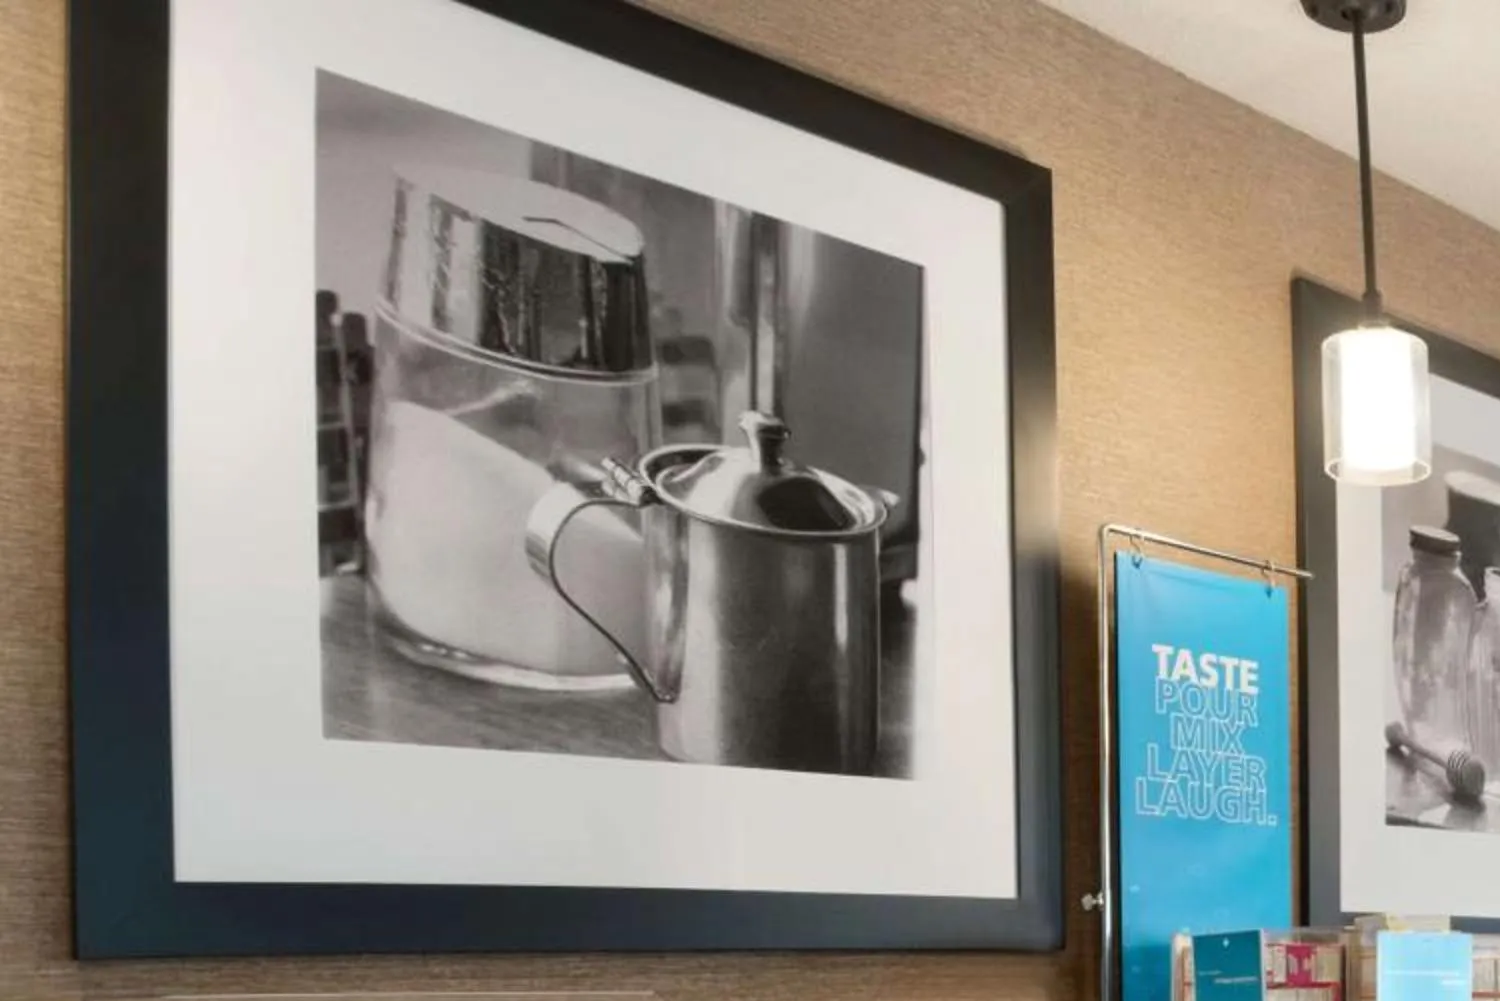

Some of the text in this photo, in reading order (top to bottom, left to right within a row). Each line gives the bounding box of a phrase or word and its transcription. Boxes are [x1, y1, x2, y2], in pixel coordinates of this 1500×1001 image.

[1152, 643, 1259, 695] TASTE
[1155, 675, 1259, 727] POUR
[1169, 712, 1245, 758] MIX
[1147, 742, 1267, 793] LAYER
[1136, 777, 1278, 827] LAUGH.
